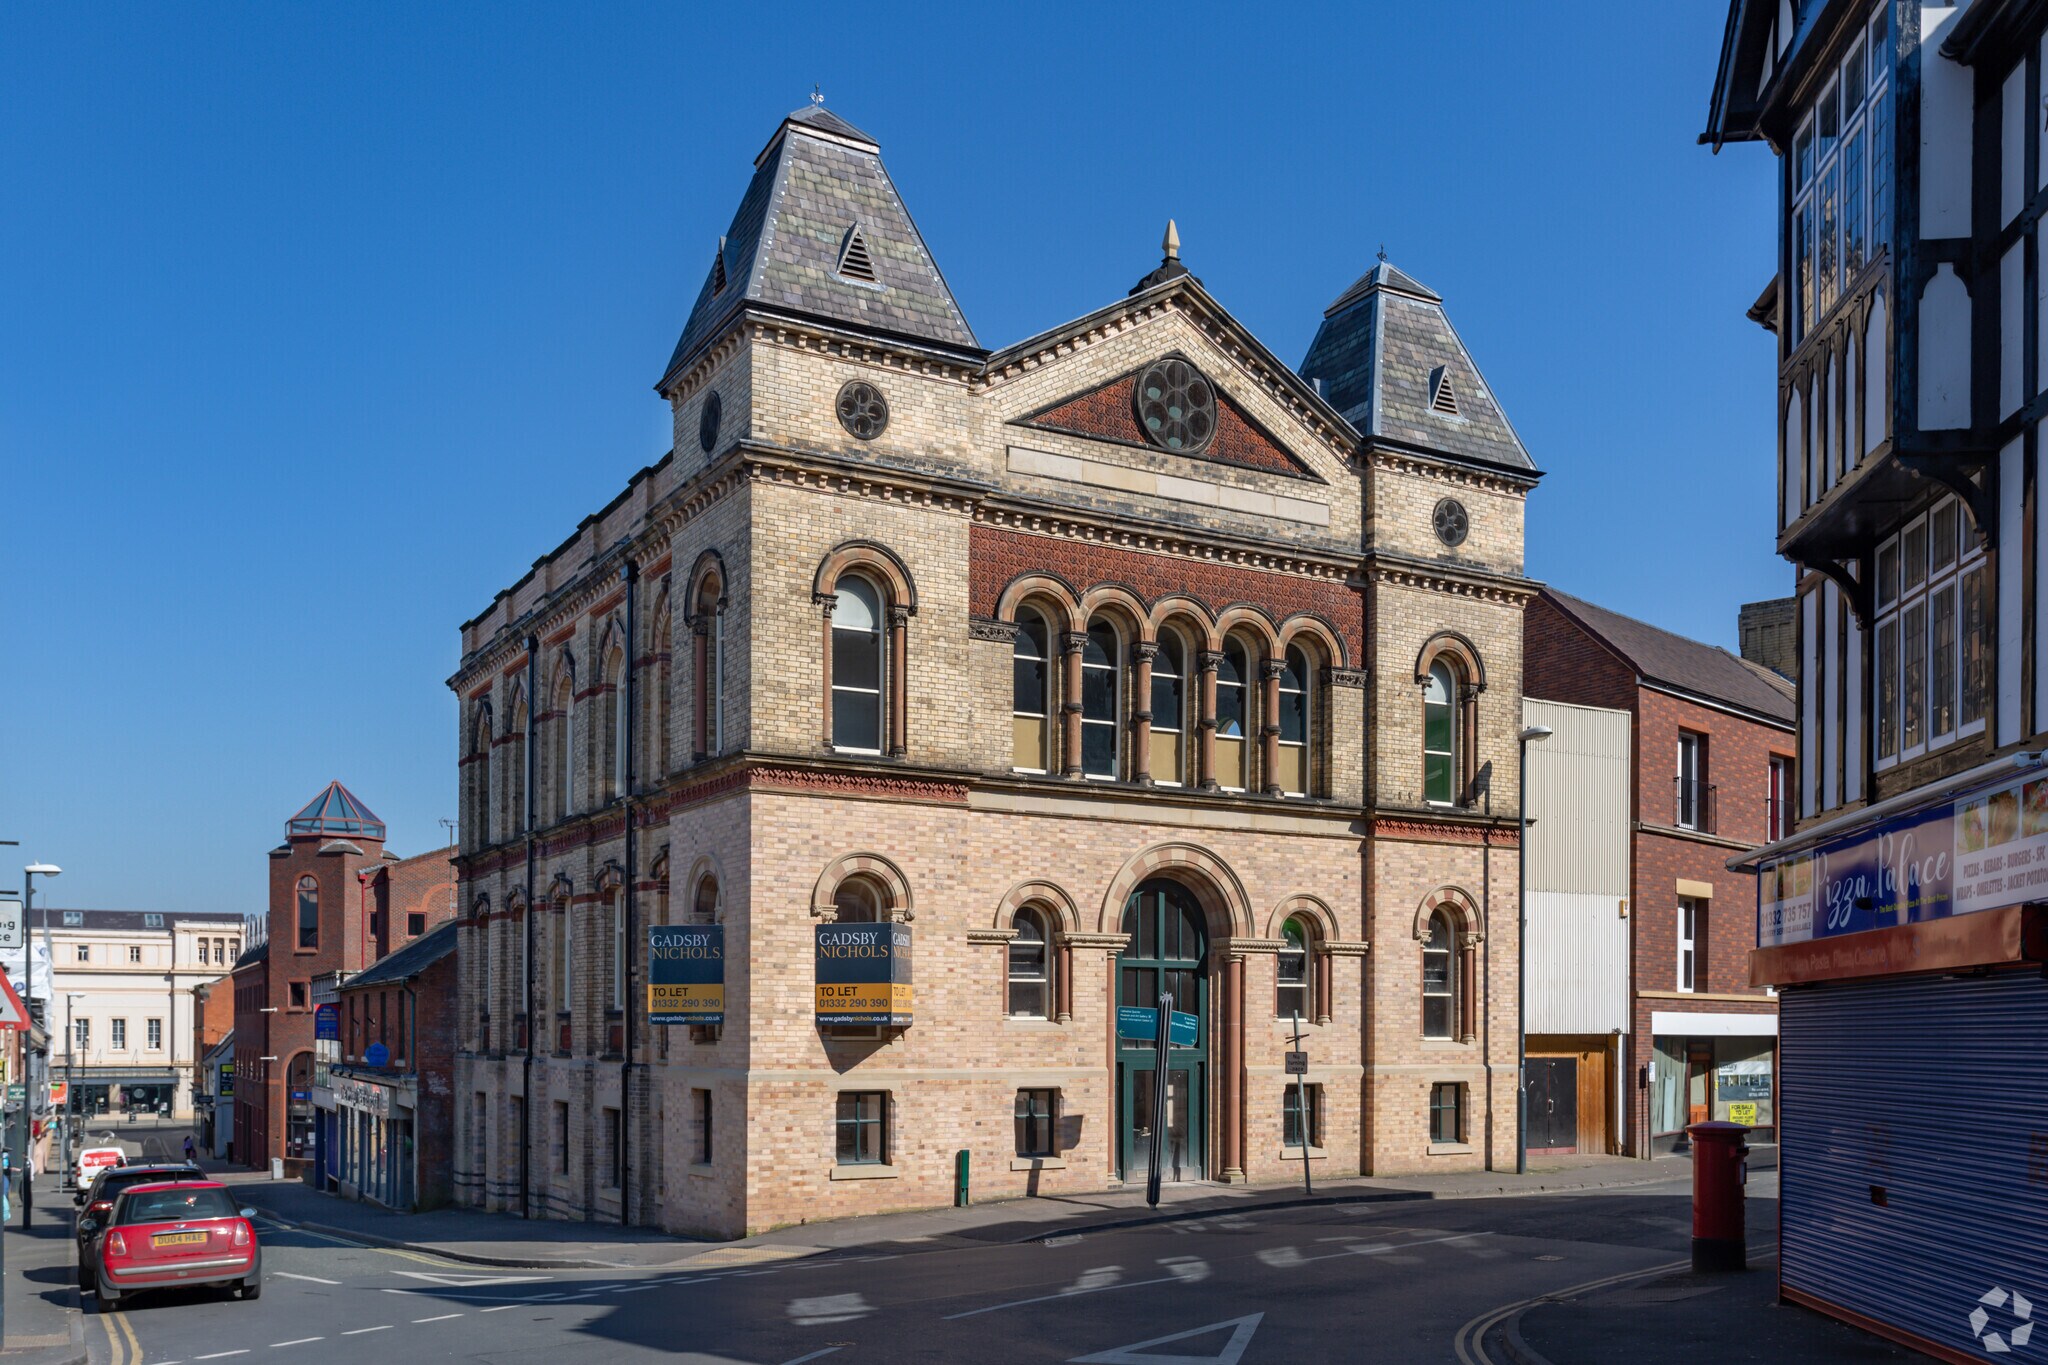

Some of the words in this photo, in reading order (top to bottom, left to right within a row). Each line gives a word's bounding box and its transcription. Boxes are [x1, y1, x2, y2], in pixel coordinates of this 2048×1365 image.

[1963, 862, 1980, 879] PIZZAS
[1984, 856, 2003, 874] KEBABS
[2007, 848, 2031, 869] BURGERS
[1815, 852, 1870, 930] Pizza
[1876, 832, 1950, 899] Palace
[1956, 884, 1973, 901] WRAPS
[1976, 877, 2003, 897] OMELETTES
[2007, 872, 2026, 891] JACKET
[2026, 867, 2048, 886] POTATO
[1784, 905, 1797, 924] 735
[1797, 902, 1812, 920] 757
[651, 934, 711, 947] GADSBY
[819, 932, 878, 945] GADSBY
[651, 946, 721, 960] NICHOLS
[819, 945, 889, 959] NICHOLS
[652, 987, 666, 997] TO
[669, 987, 689, 997] LET
[819, 986, 834, 997] TO
[837, 986, 858, 997] LET
[651, 998, 679, 1008] 01332
[681, 998, 700, 1008] 290
[702, 998, 721, 1008] 390
[819, 998, 847, 1008] 01332
[849, 998, 868, 1008] 290
[870, 998, 888, 1008] 390
[651, 1015, 721, 1023] www.gadsbynichols.co.uk
[819, 1015, 888, 1023] www.gadsbynichols.co.uk
[185, 1233, 205, 1242] HAE
